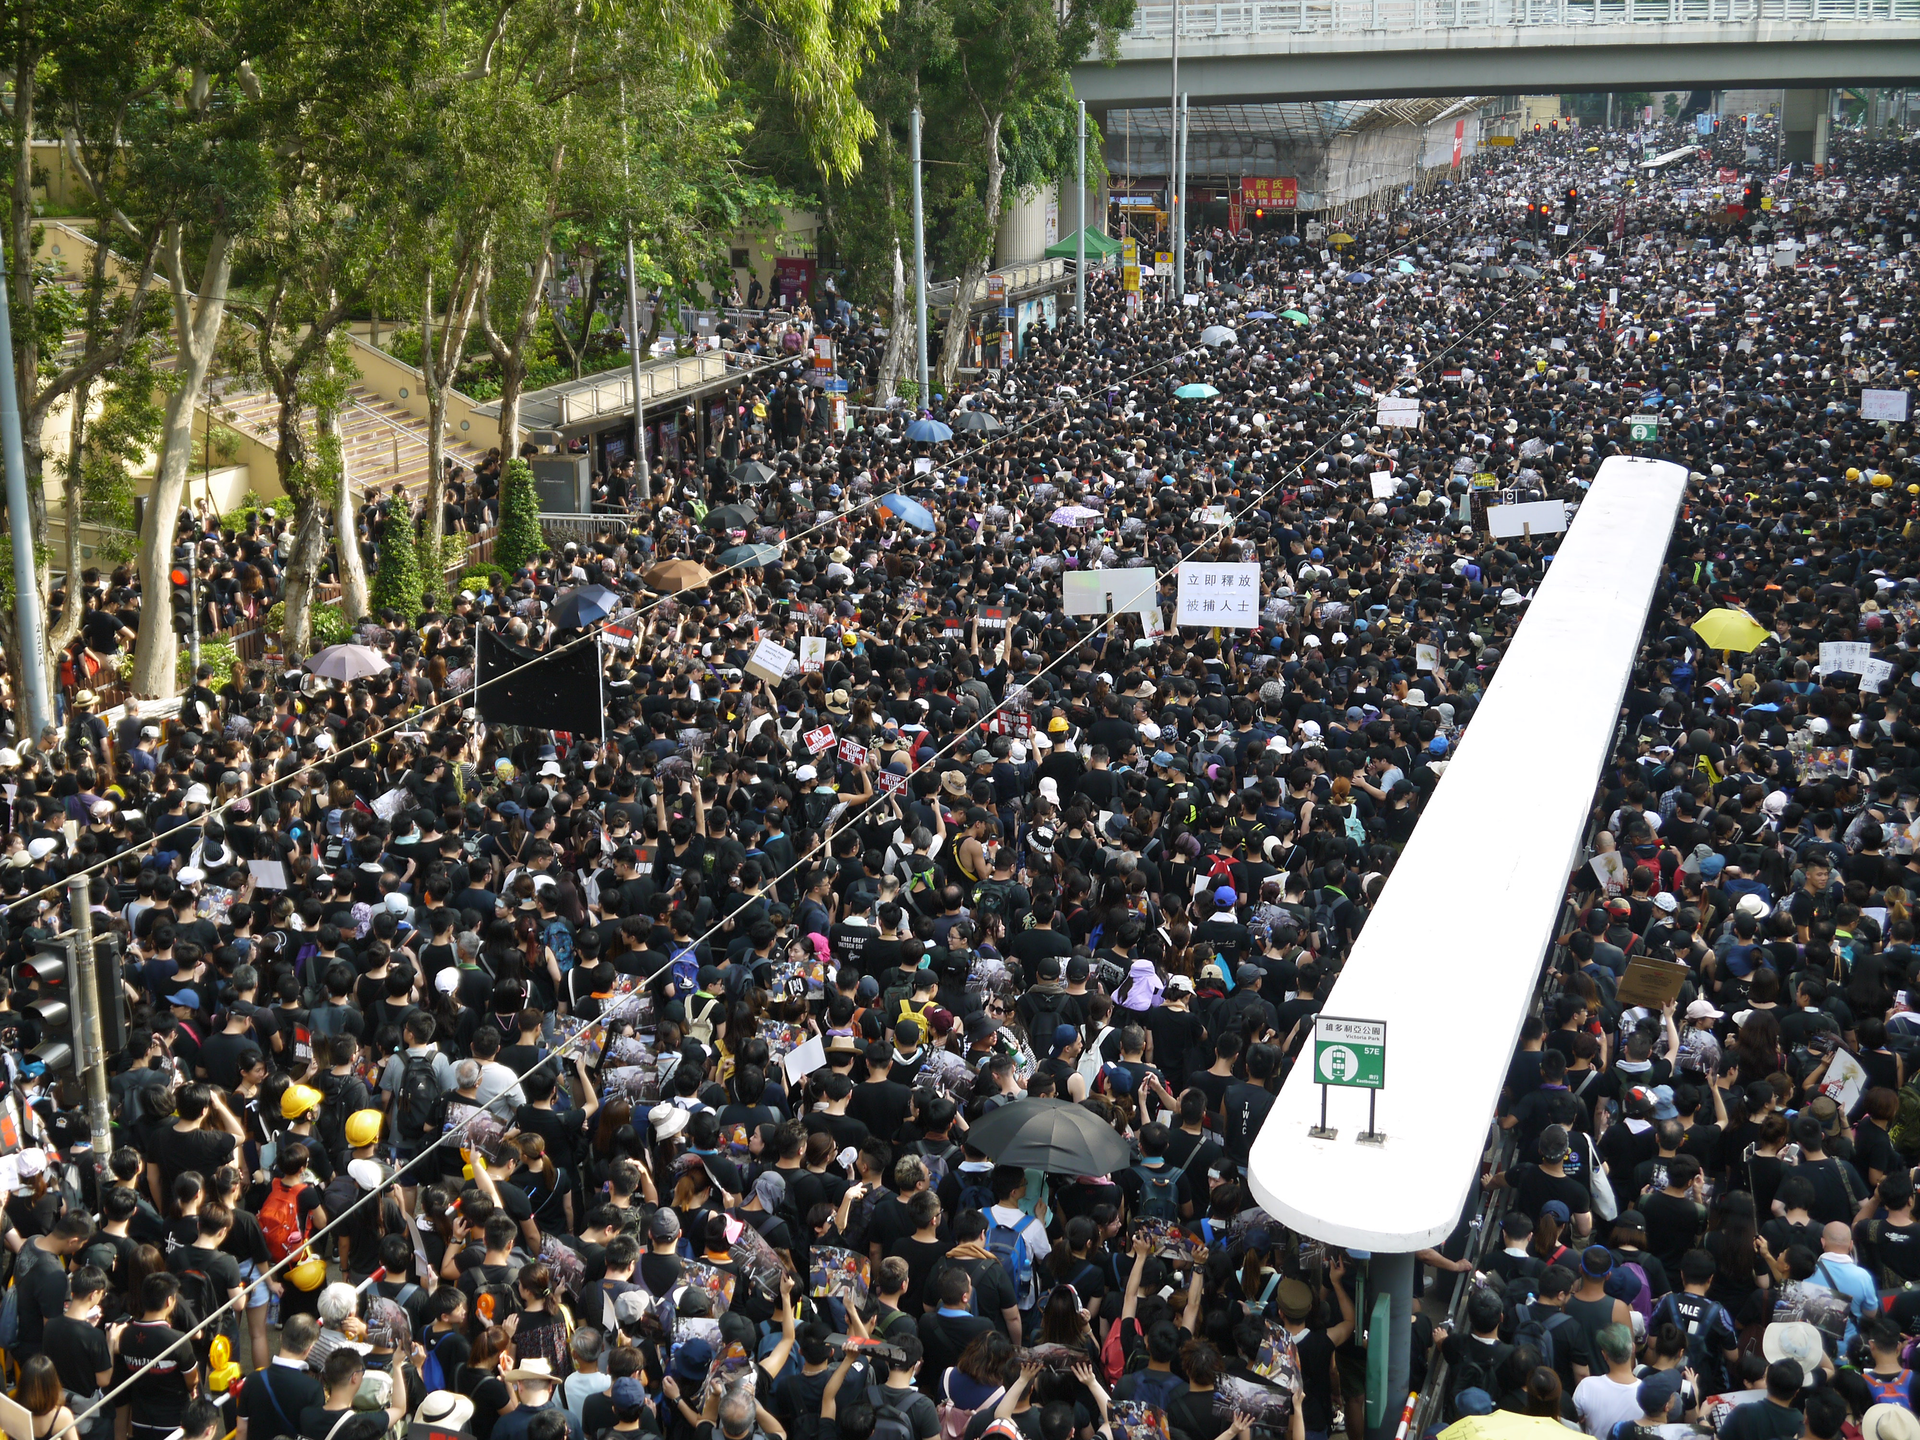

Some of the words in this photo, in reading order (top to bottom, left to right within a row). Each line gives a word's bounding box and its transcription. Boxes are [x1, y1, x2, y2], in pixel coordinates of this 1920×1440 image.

[1256, 179, 1284, 190] 許氏
[1187, 574, 1251, 587] 立即釋放
[1186, 598, 1250, 612] 被捕人士
[810, 730, 824, 742] NO
[846, 742, 860, 752] STOP
[841, 747, 863, 760] KILLING
[881, 778, 904, 789] KILLING
[1326, 1022, 1380, 1035] 維多利亞公園
[1364, 1047, 1380, 1055] 57E
[1242, 1101, 1250, 1135] TWAC
